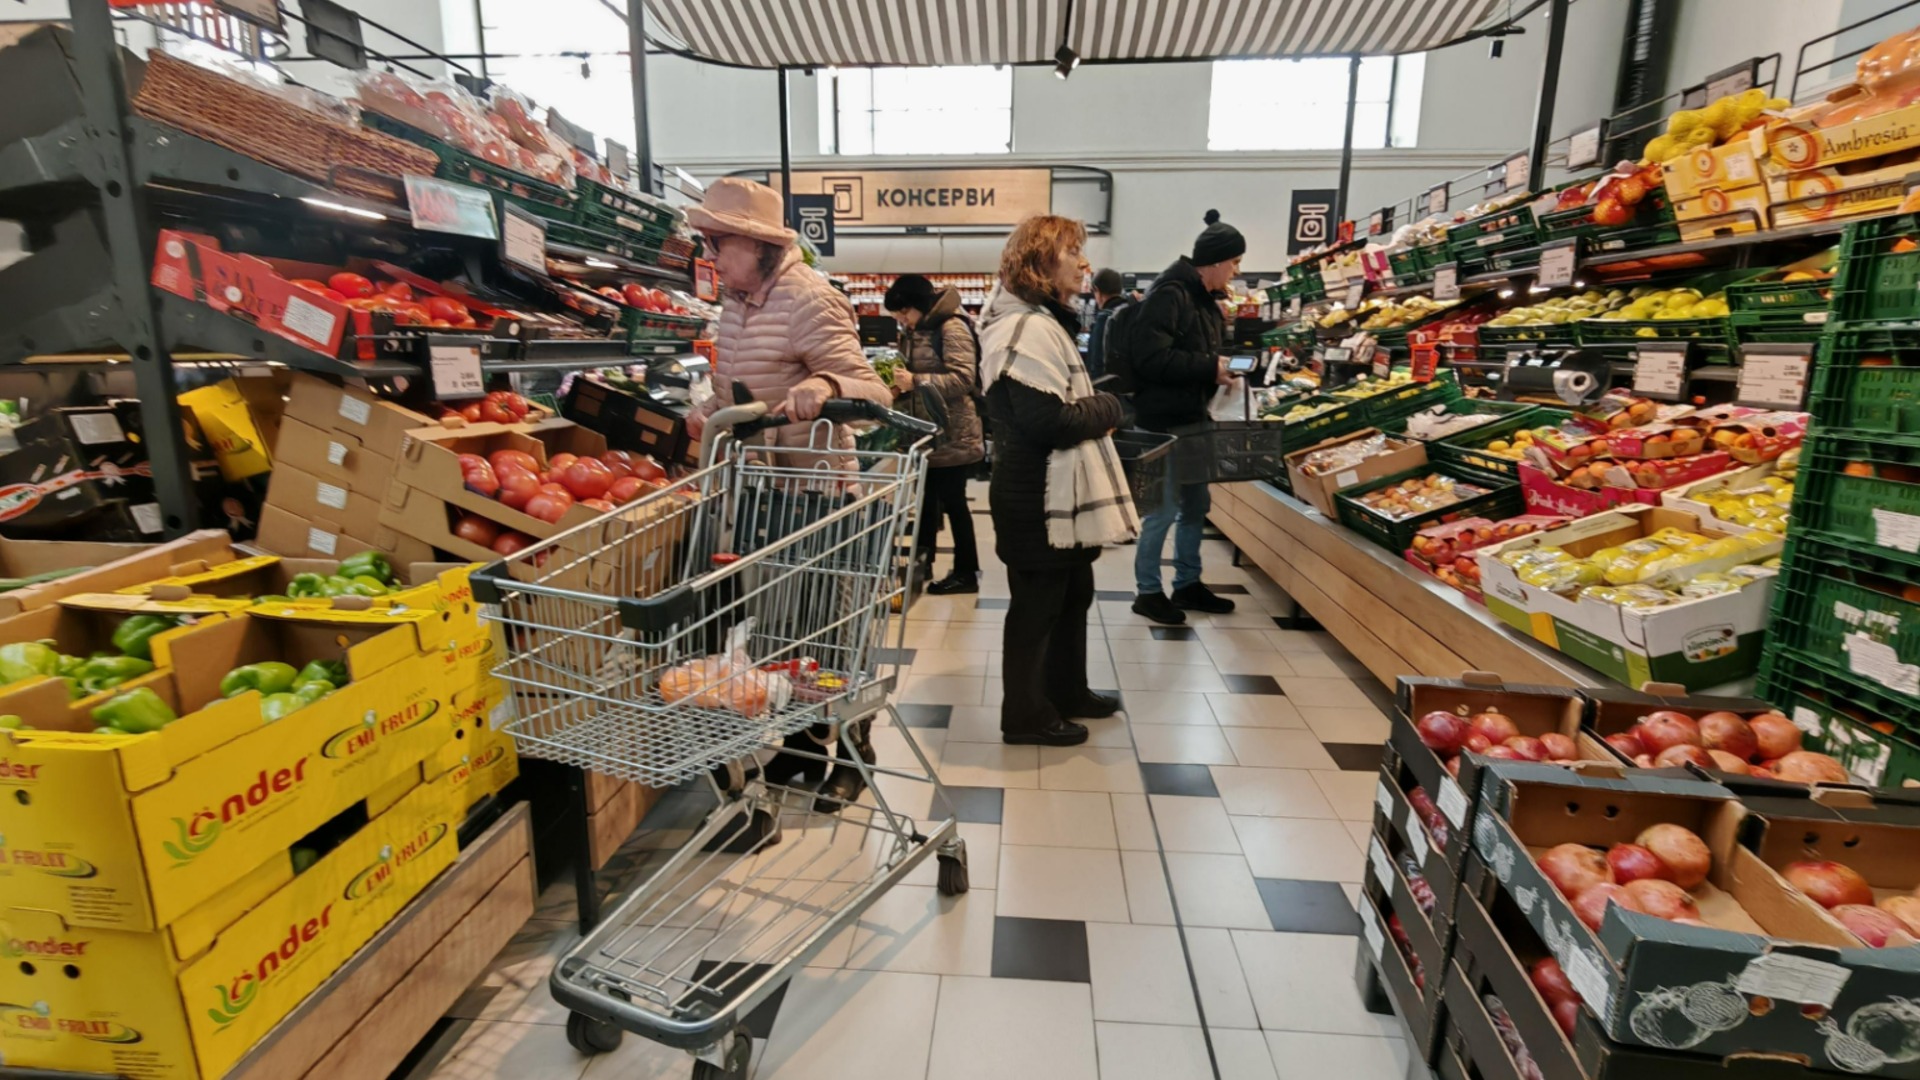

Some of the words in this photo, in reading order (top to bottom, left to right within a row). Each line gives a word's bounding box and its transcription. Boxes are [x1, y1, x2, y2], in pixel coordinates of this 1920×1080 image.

[1823, 122, 1909, 157] Ambrosia
[876, 187, 995, 208] КОНСЕРВИ
[346, 728, 376, 756] EMI
[380, 702, 420, 736] FRUIT
